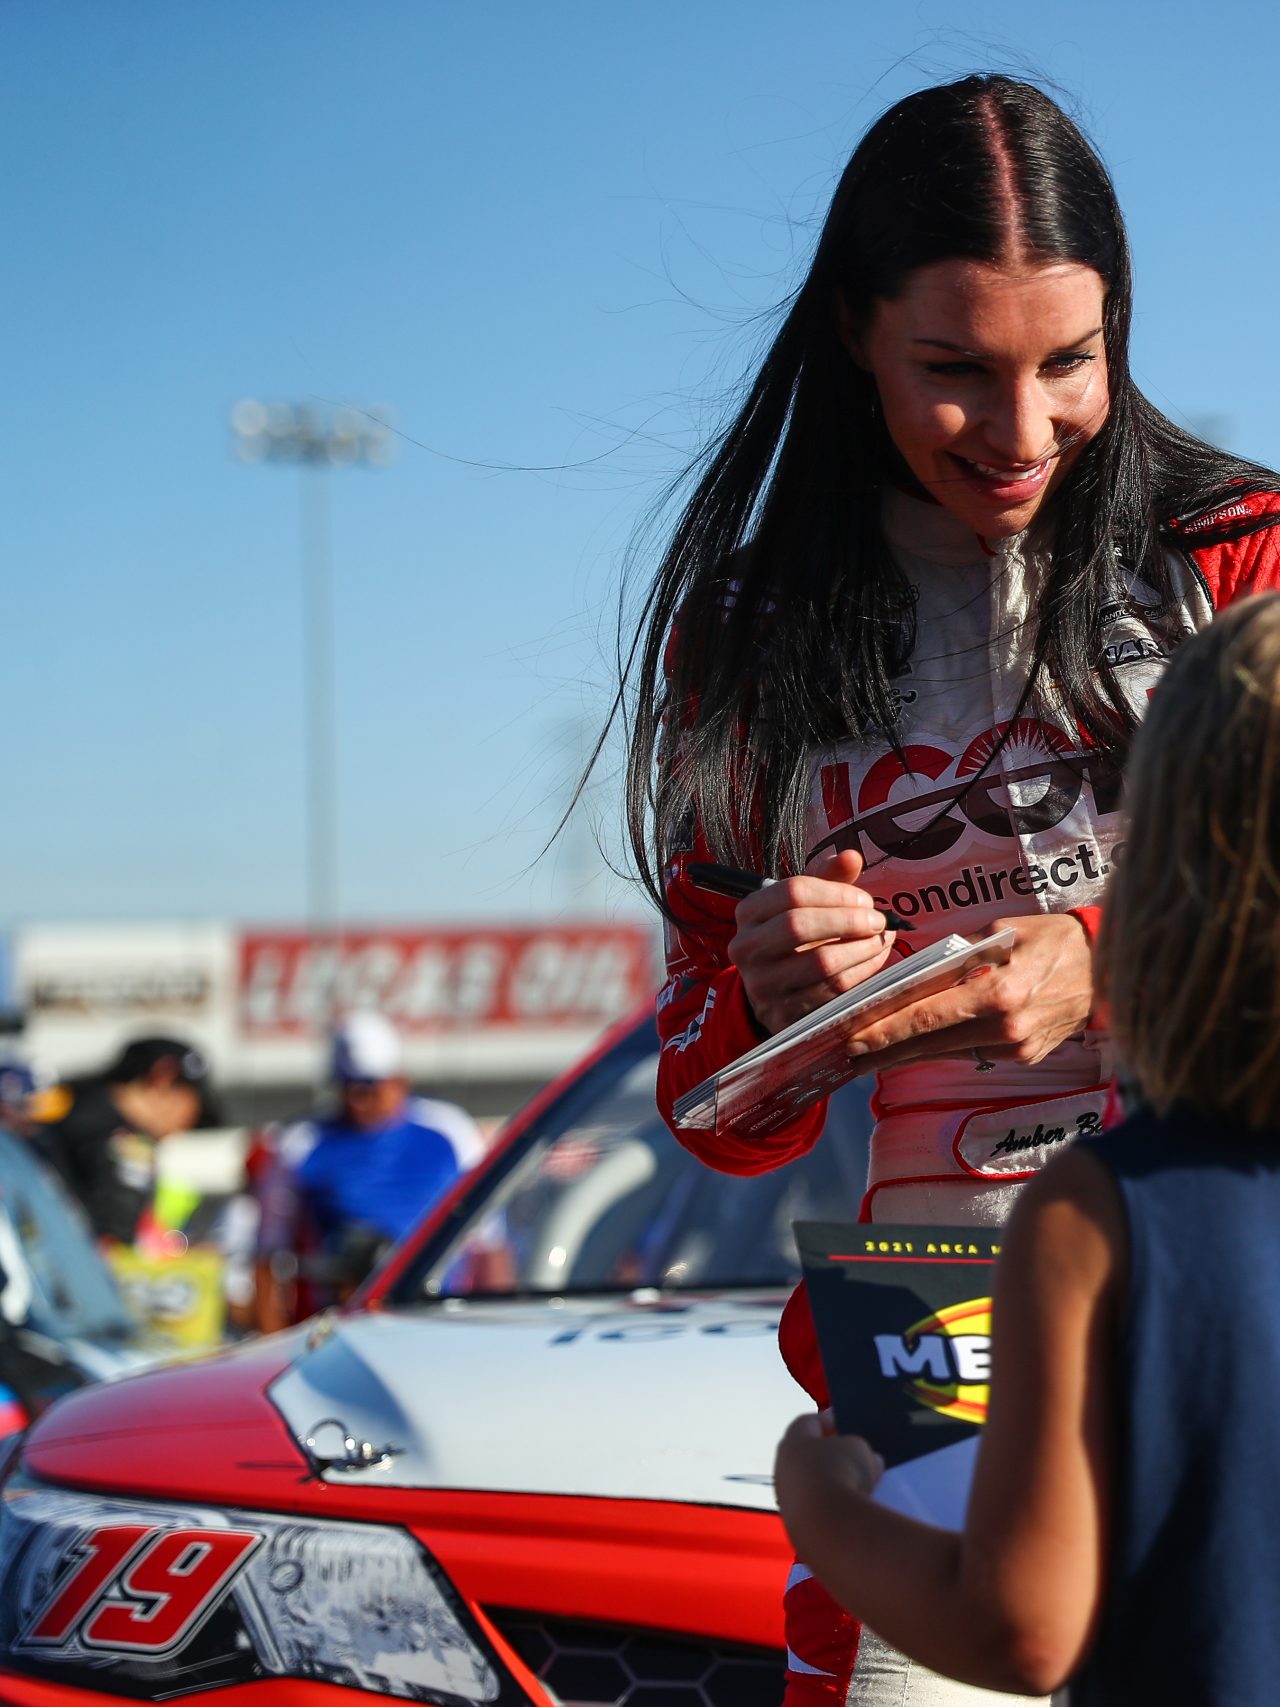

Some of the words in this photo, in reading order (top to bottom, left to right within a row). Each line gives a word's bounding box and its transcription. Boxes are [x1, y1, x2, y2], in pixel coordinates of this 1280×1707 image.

[990, 1123, 1066, 1158] Amber
[864, 1240, 914, 1253] 2021
[926, 1242, 978, 1255] ARCA
[873, 1332, 992, 1381] ME
[20, 1522, 264, 1658] 19
